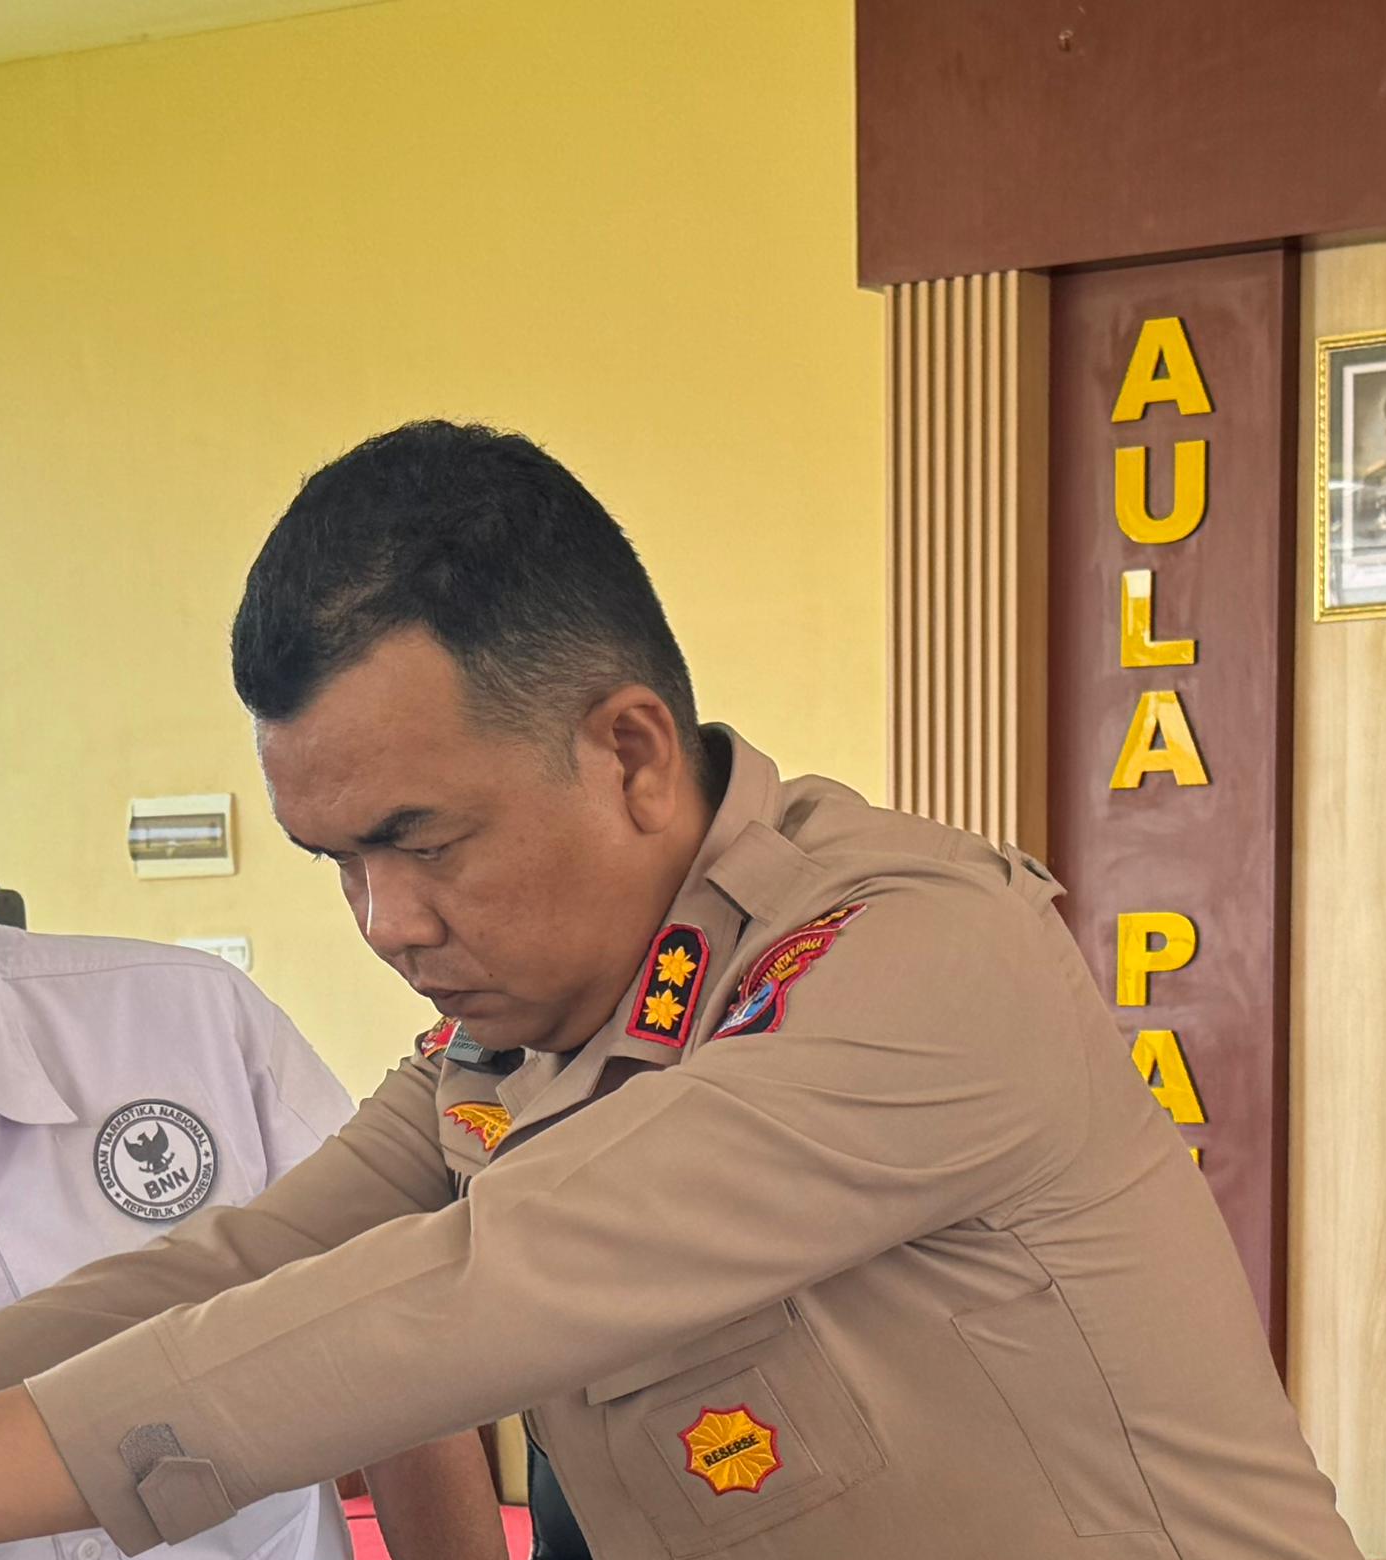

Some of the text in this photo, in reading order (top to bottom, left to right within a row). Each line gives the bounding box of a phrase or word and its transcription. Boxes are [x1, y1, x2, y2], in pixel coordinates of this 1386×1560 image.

[1111, 316, 1215, 790] AULA
[1116, 911, 1206, 1166] PA
[99, 1105, 208, 1190] BADAN NARKOTIKA NASIONAL
[143, 1167, 191, 1200] BNN
[177, 1162, 213, 1213] INDONESIA
[702, 1433, 761, 1468] RESERSE
